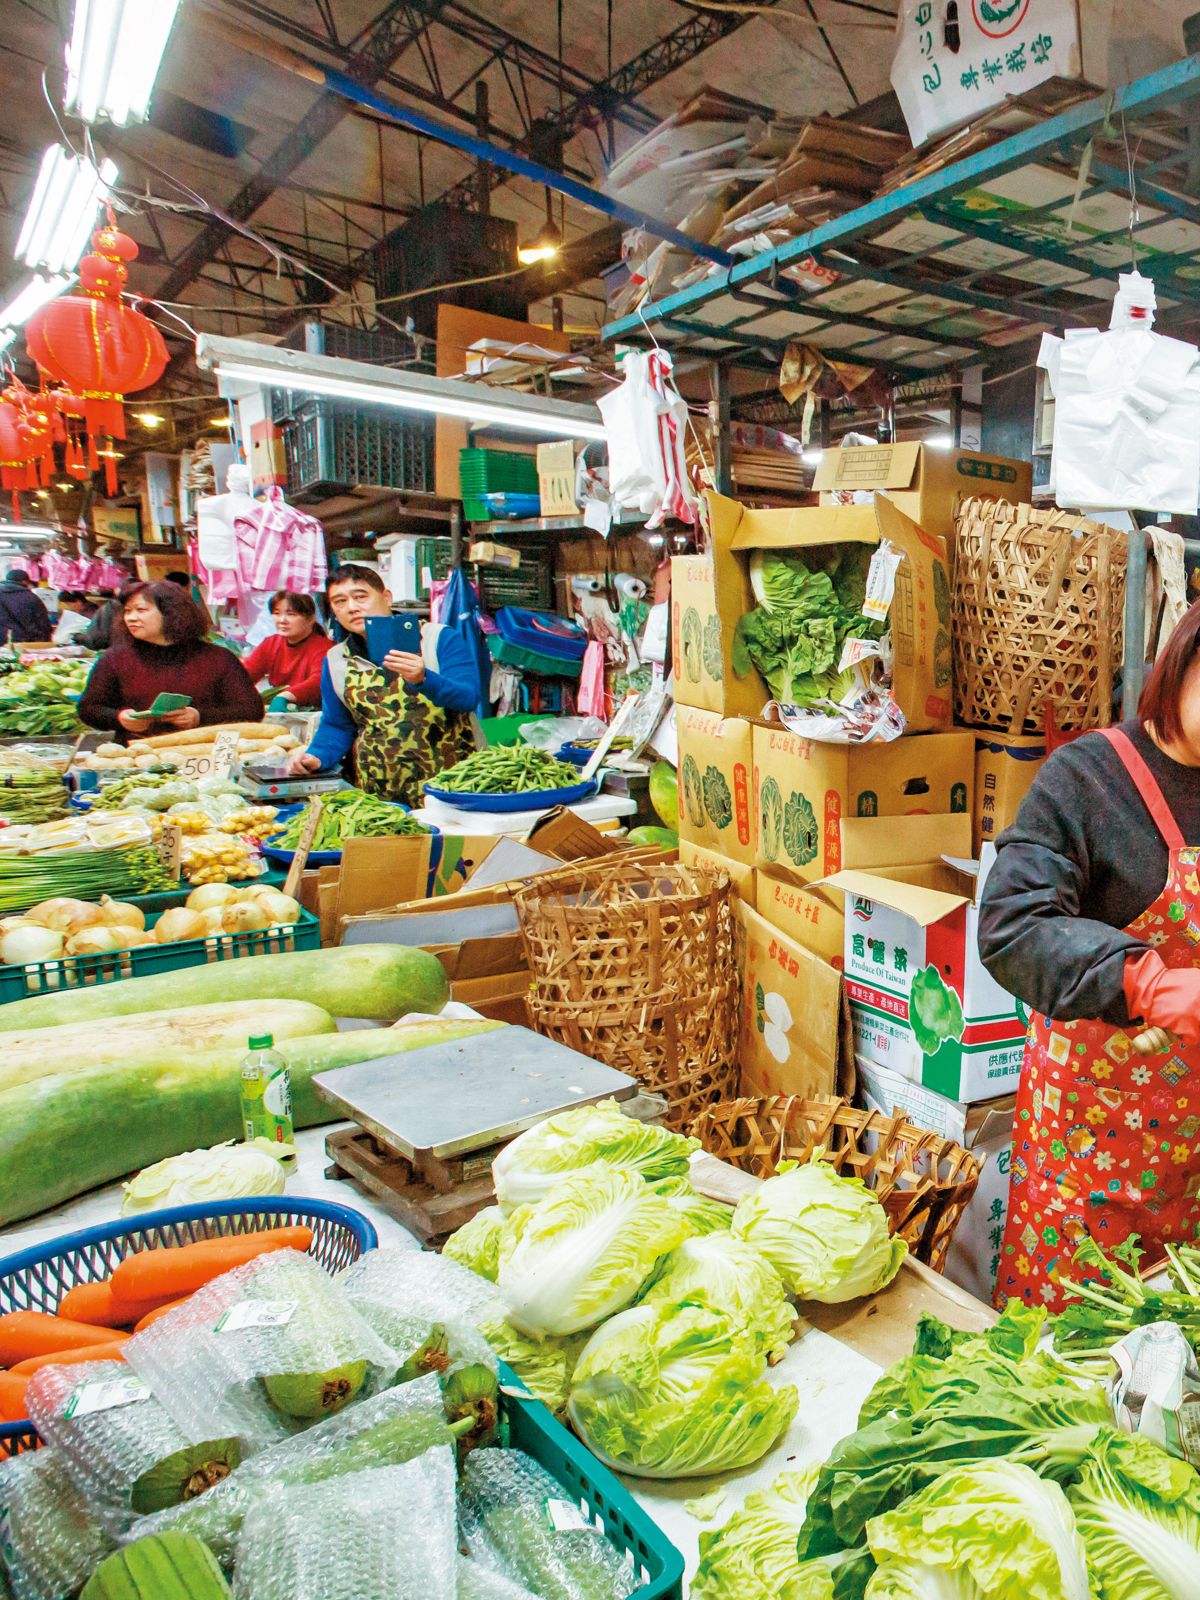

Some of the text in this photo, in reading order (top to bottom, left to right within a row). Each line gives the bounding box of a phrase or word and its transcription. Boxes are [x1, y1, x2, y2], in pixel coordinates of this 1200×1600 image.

[184, 757, 211, 775] 50
[981, 773, 996, 842] 自然健
[852, 933, 908, 973] 高麗菜
[851, 958, 906, 986] Produce Of Taiwan
